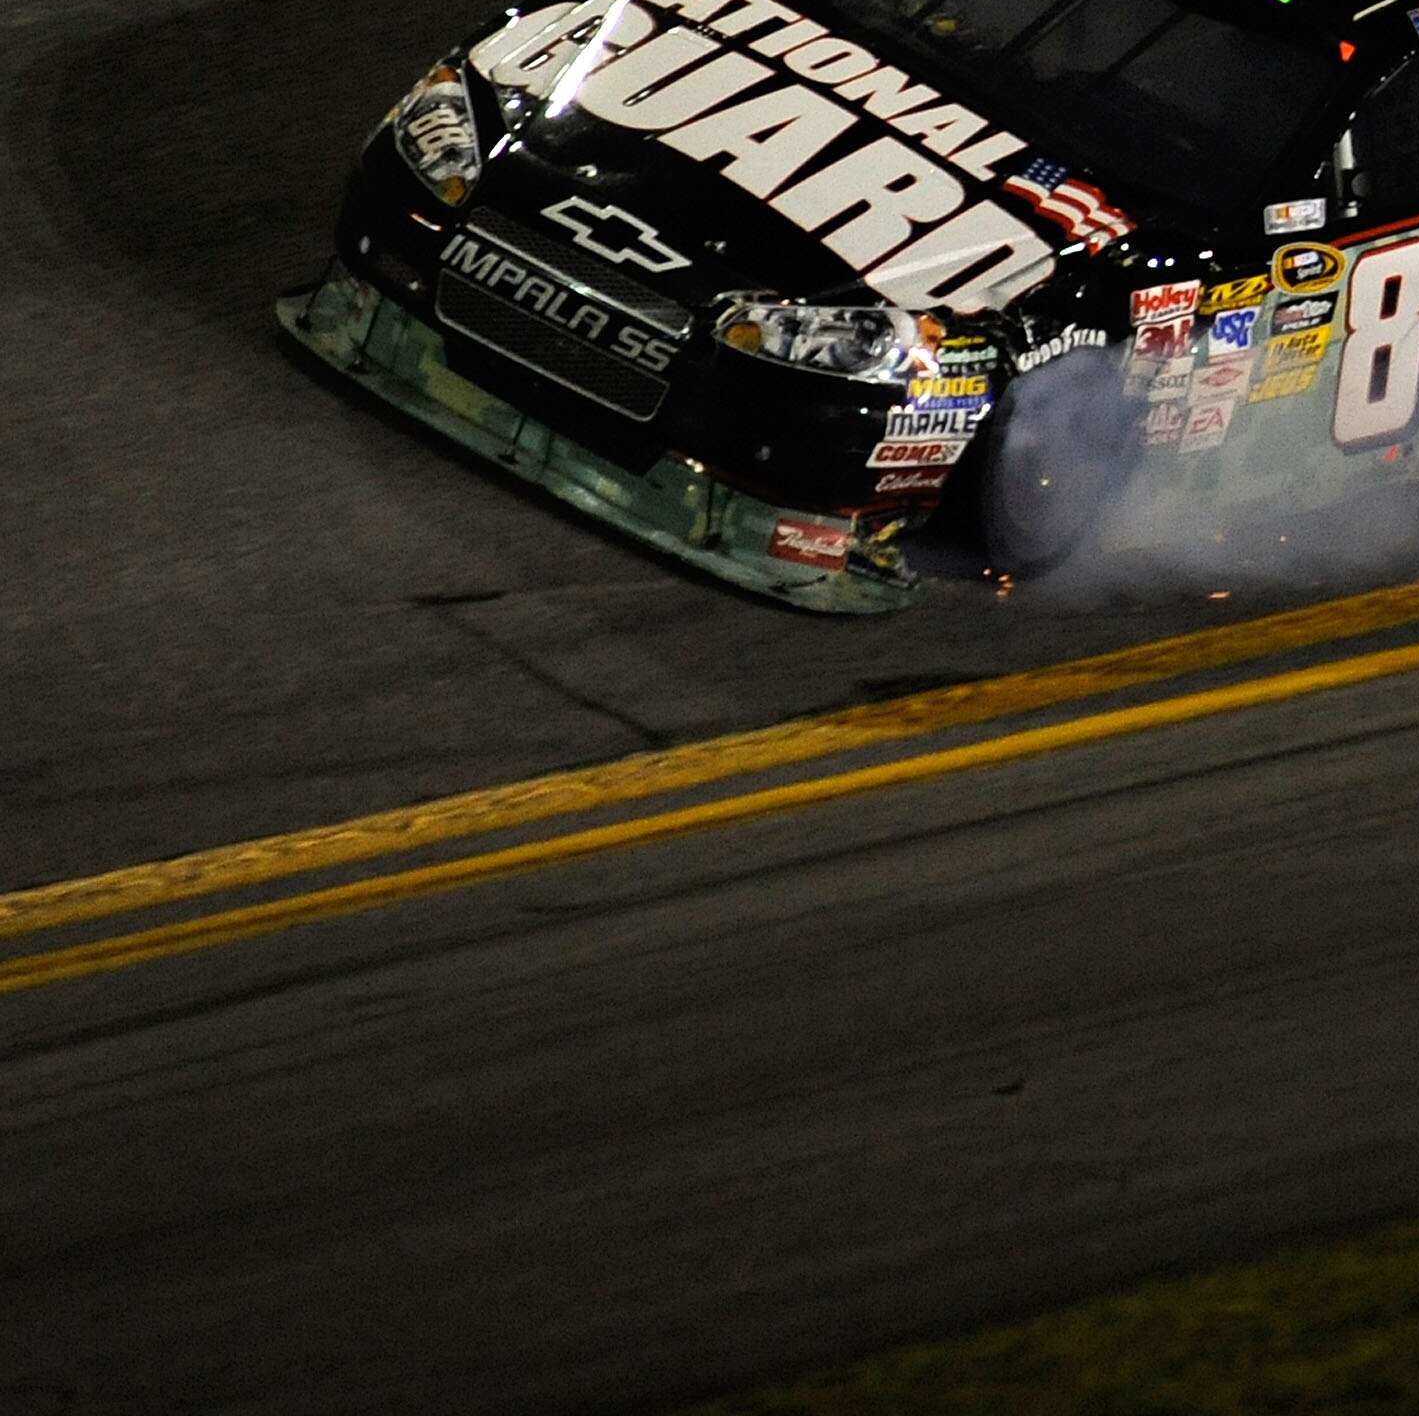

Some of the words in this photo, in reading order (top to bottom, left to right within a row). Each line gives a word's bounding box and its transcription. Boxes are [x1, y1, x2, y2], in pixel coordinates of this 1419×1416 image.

[467, 1, 1057, 314] GUARD
[439, 234, 609, 340] IMPALA
[609, 325, 681, 372] SS
[1133, 285, 1197, 317] Holley
[1015, 322, 1107, 373] GOODYEAR
[908, 374, 988, 400] MOOG
[888, 409, 977, 438] MAHLE
[874, 444, 944, 463] COMP
